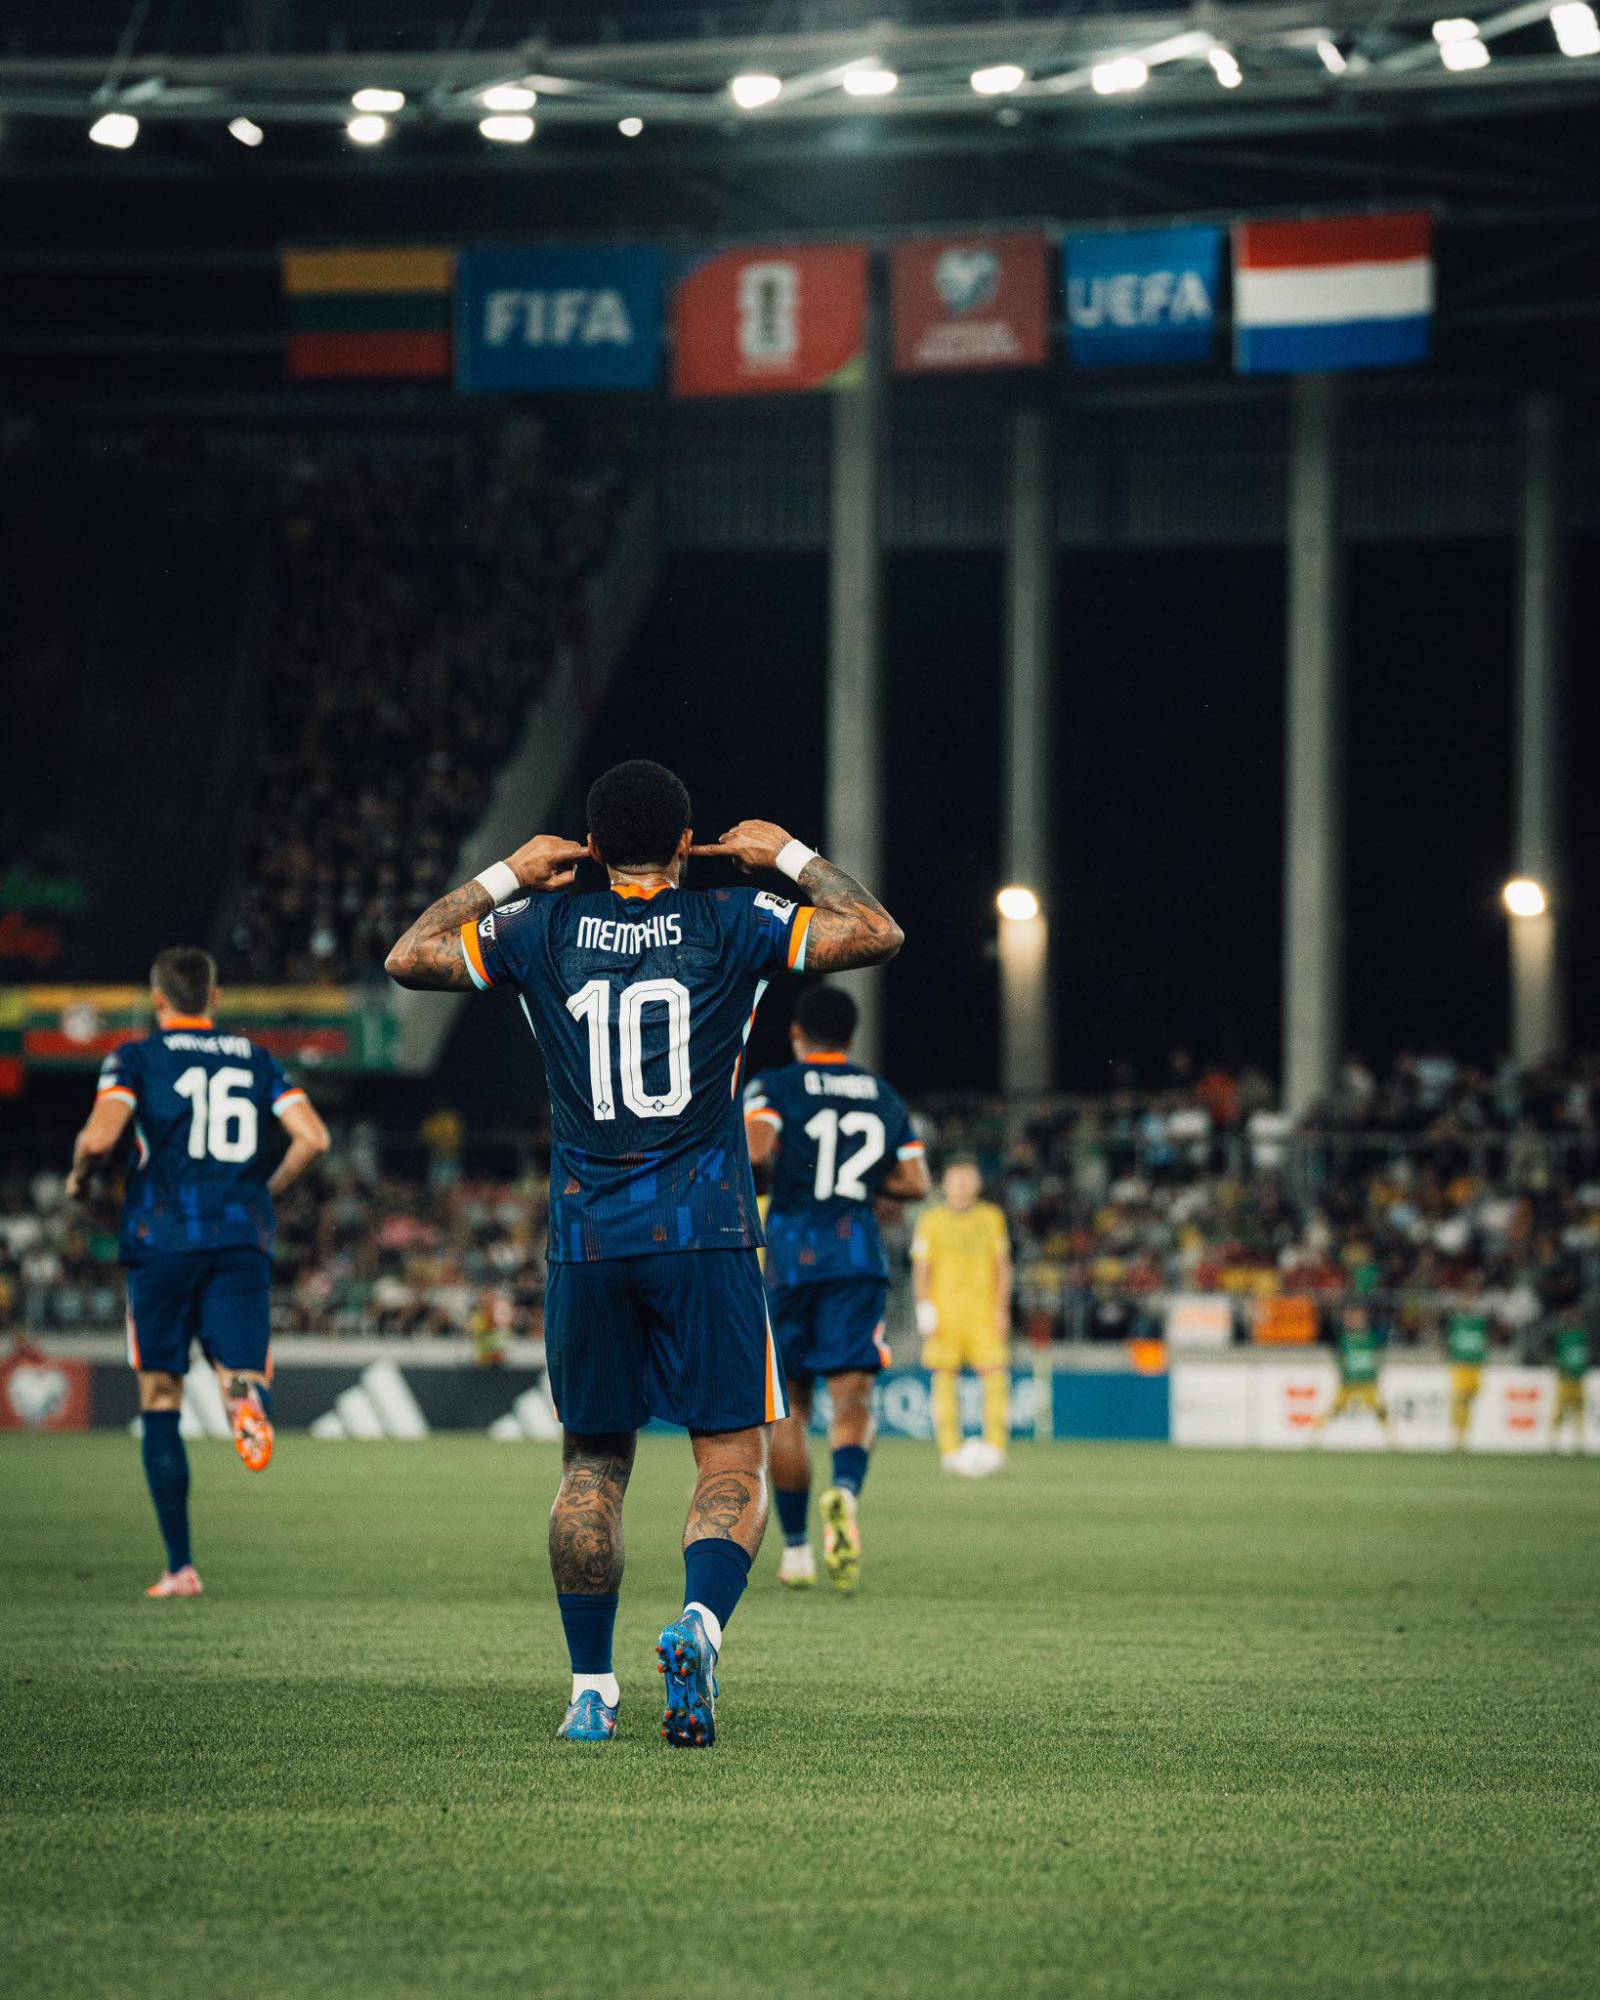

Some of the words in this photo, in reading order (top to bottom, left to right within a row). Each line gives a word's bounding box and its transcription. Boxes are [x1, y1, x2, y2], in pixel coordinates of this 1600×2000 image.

[486, 290, 632, 345] FIFA
[1067, 269, 1213, 328] UEFA
[576, 913, 682, 955] MEMPHIS
[565, 978, 693, 1120] 10
[173, 1066, 258, 1163] 16
[804, 1108, 886, 1200] 12
